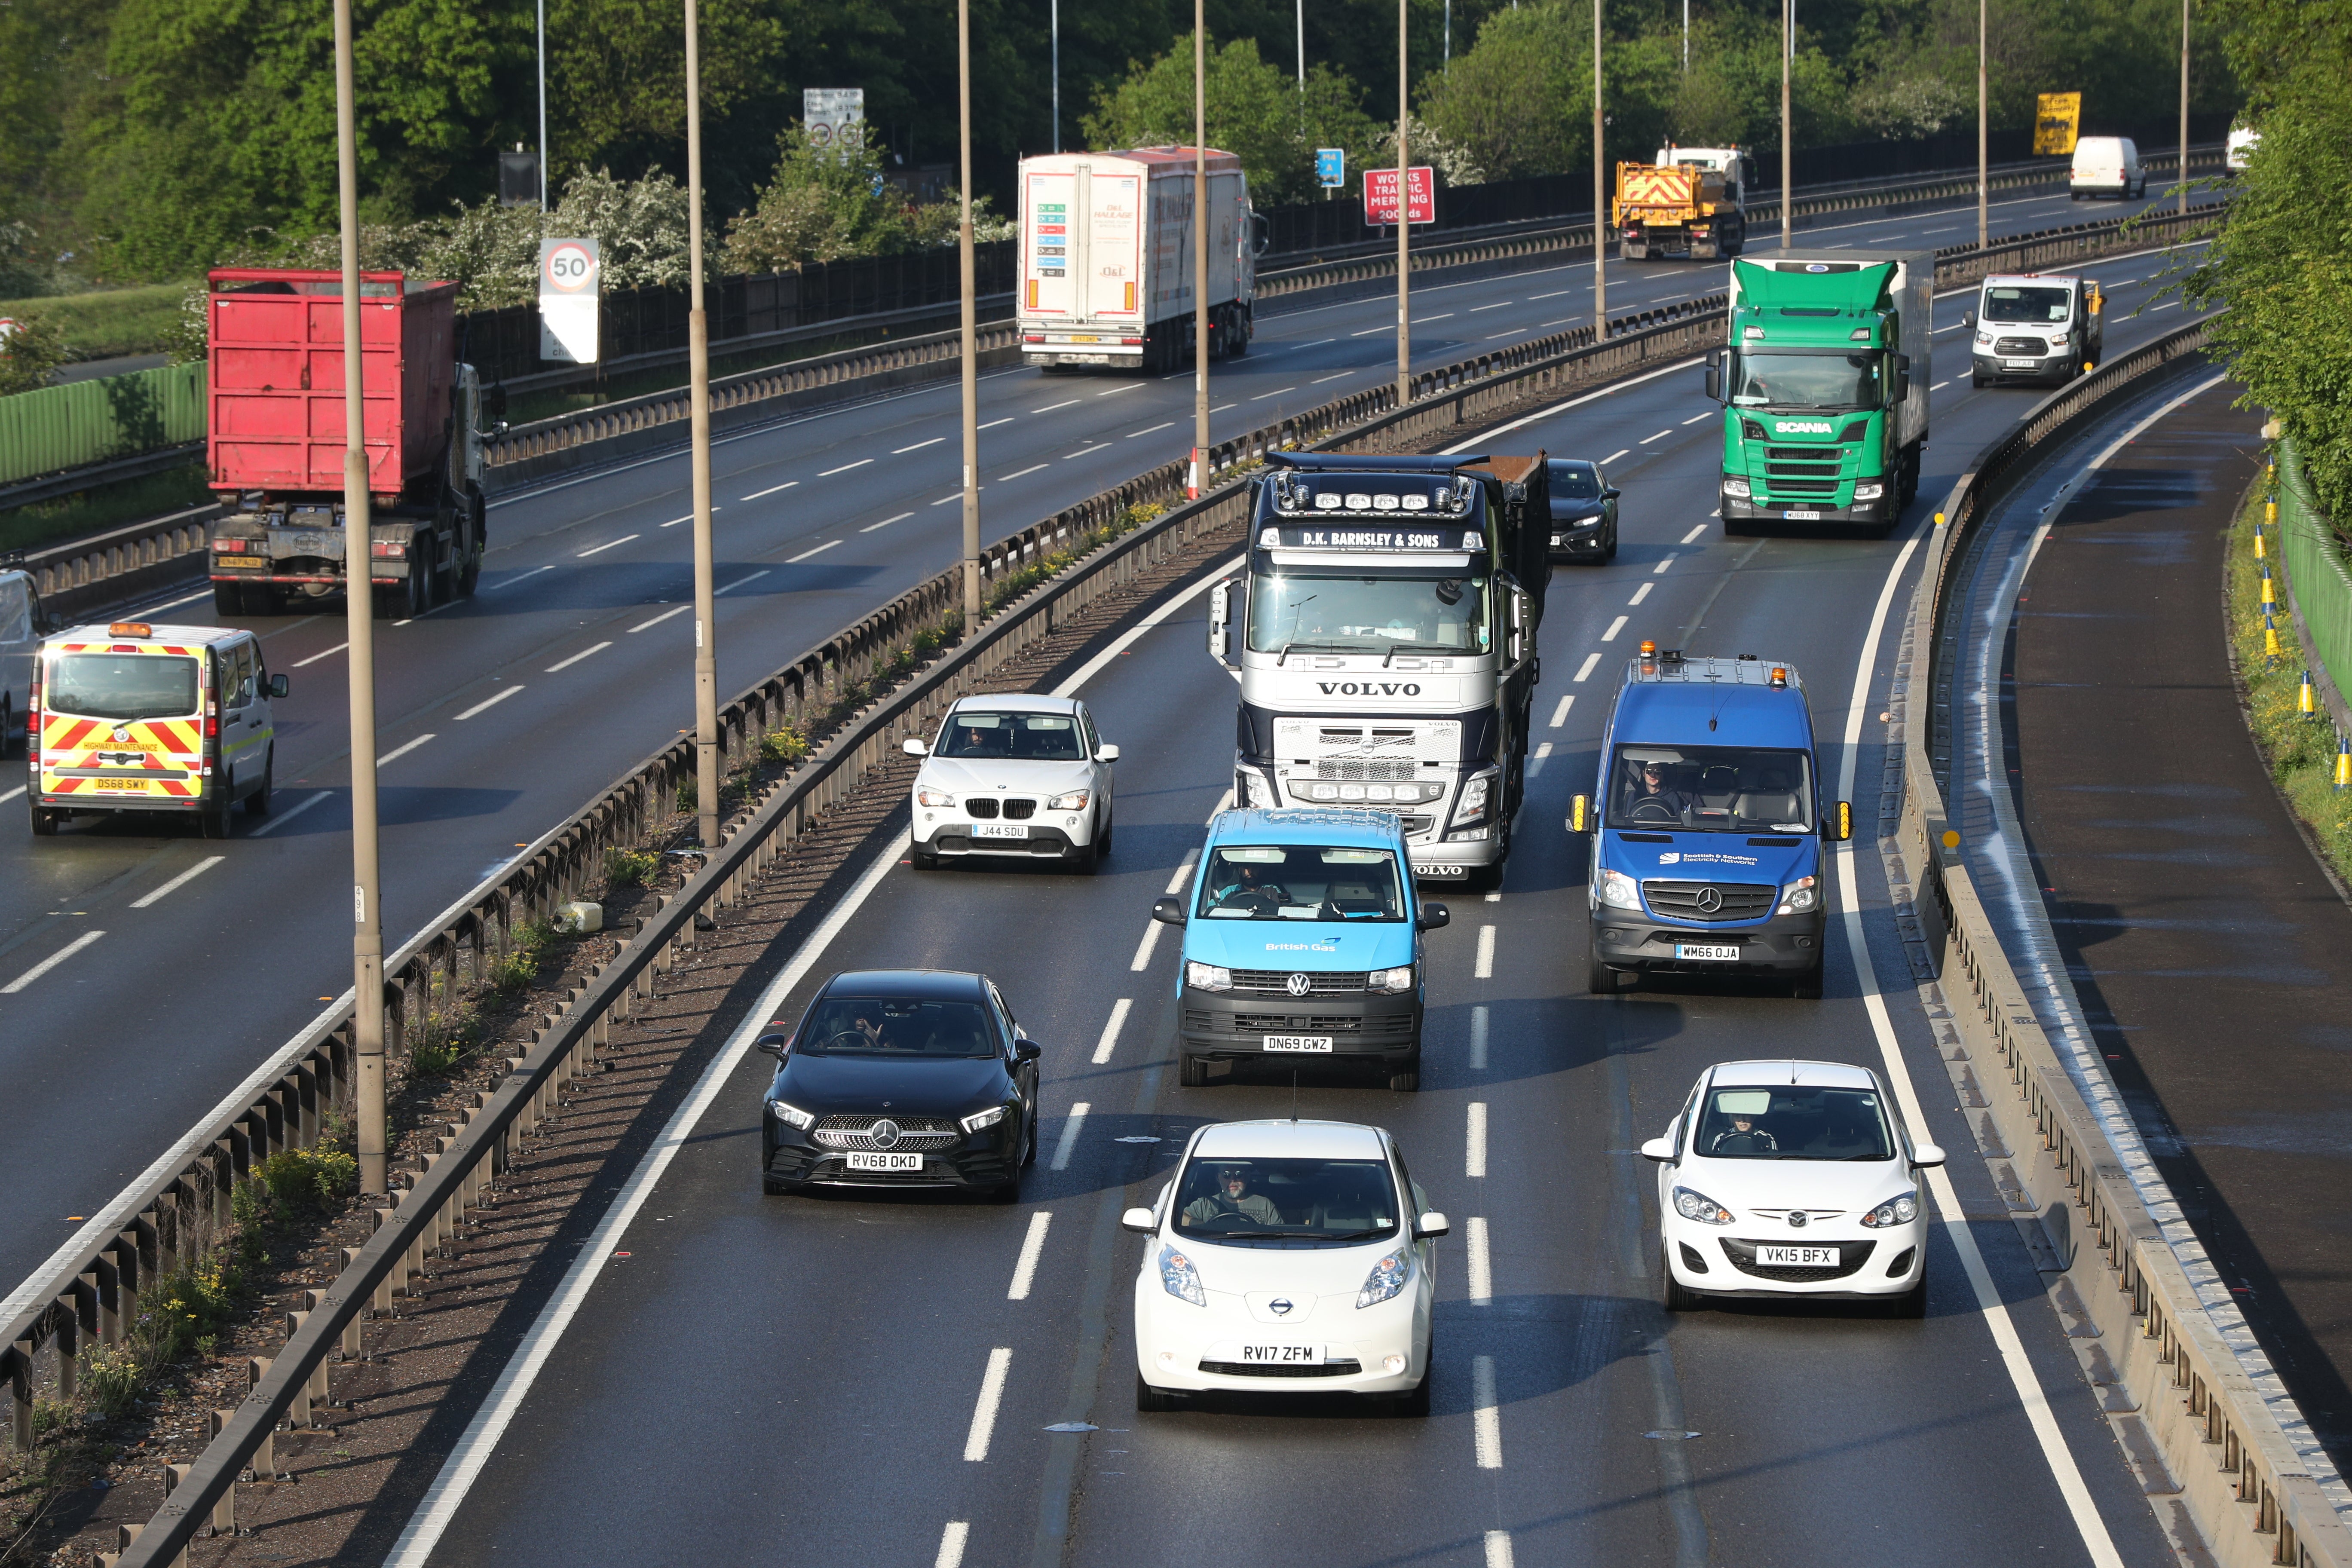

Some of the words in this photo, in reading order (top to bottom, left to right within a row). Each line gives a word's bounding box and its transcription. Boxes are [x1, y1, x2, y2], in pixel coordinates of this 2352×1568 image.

[1376, 172, 1420, 184] WOKS
[1374, 183, 1423, 195] TRAIC
[1371, 194, 1428, 206] MERNG
[554, 257, 585, 277] 50
[1776, 422, 1832, 433] SCANIA
[1303, 532, 1328, 545] D.K.
[1331, 533, 1392, 546] BARNSLEY
[1394, 534, 1405, 546] &
[1407, 534, 1439, 548] SONS
[1316, 682, 1421, 696] VOLVO
[98, 779, 123, 788] DS68
[126, 780, 146, 789] SWY
[983, 827, 1001, 836] J44
[1004, 827, 1023, 836] SDU
[1684, 946, 1712, 957] WM66
[1716, 948, 1736, 958] OJA
[1269, 1038, 1300, 1049] DN69
[1304, 1039, 1327, 1050] GWZ
[853, 1155, 886, 1167] RV68
[891, 1156, 916, 1168] OKD
[1766, 1248, 1798, 1262] VK15
[1802, 1249, 1830, 1262] BFX
[1244, 1346, 1277, 1360] RV17
[1283, 1347, 1311, 1361] ZFM
